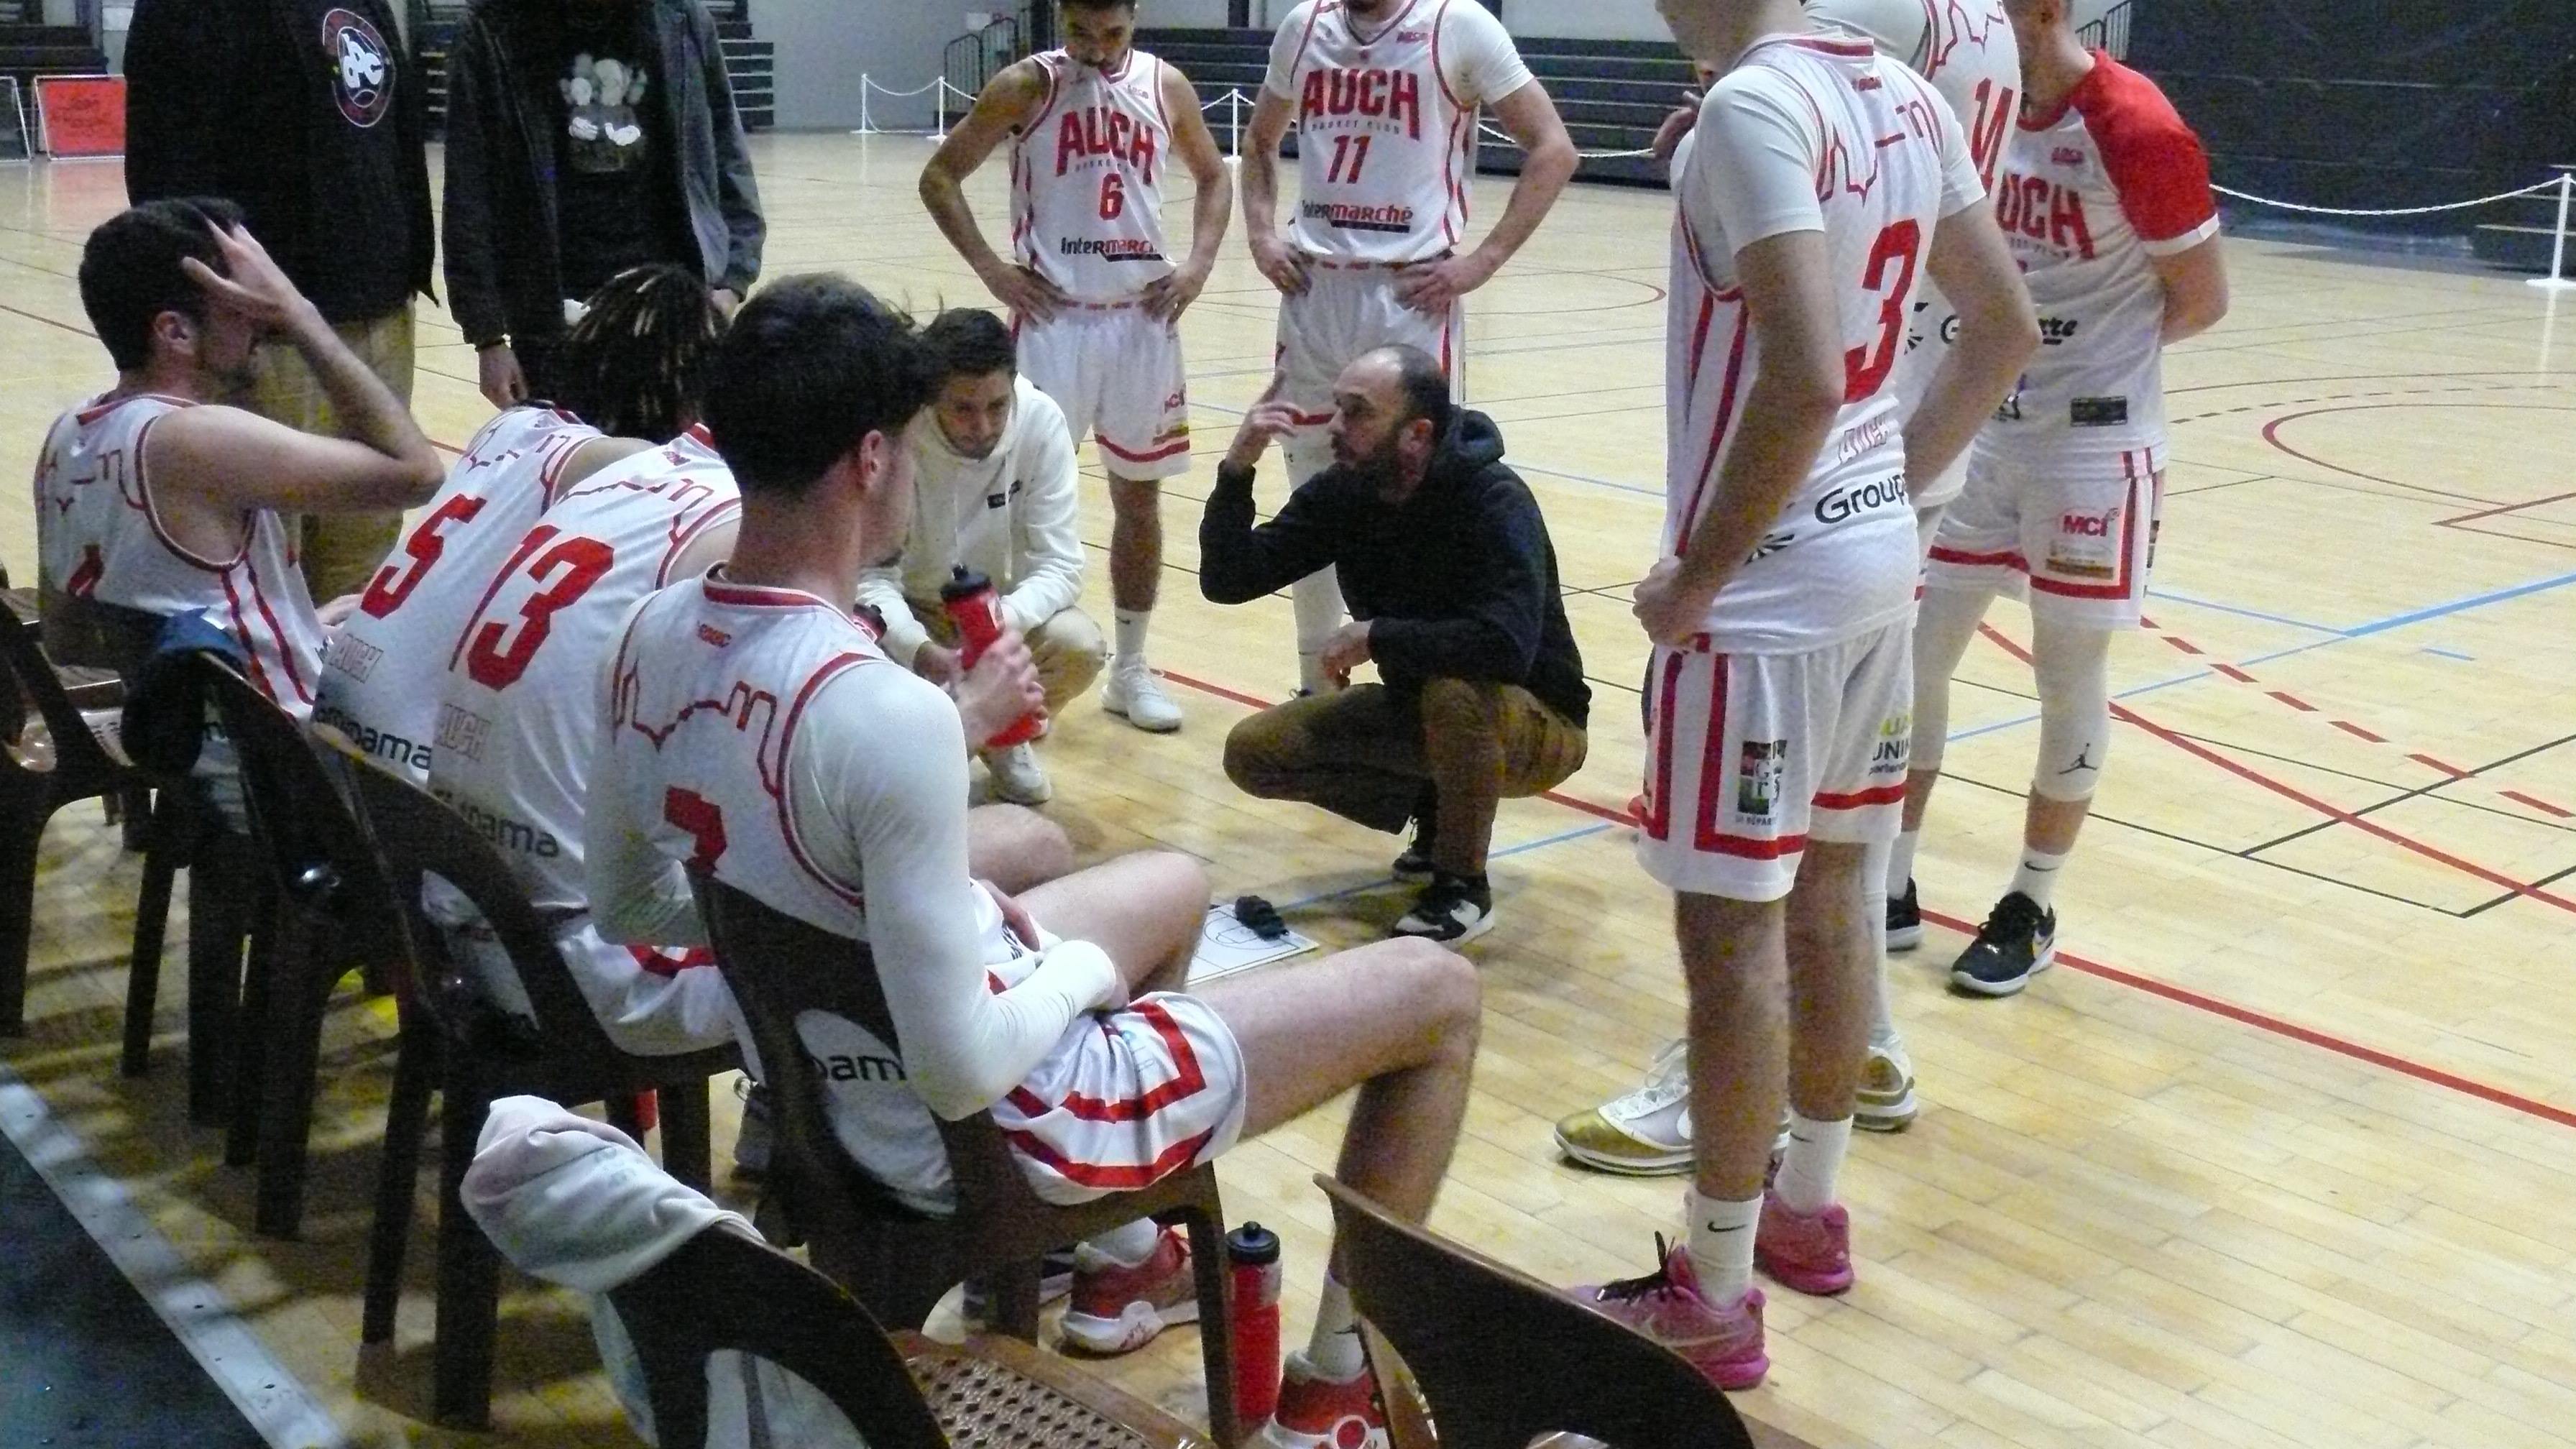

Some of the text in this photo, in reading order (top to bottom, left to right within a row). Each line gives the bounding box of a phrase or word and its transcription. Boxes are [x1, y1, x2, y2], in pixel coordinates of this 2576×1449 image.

[1298, 68, 1420, 141] AUCH
[1056, 107, 1154, 187] AUCH
[1328, 134, 1371, 184] 11
[1100, 173, 1123, 220] 6
[1996, 171, 2095, 259] UCH
[1842, 218, 1920, 405] 3
[359, 493, 487, 619] 5
[448, 524, 615, 691] 13
